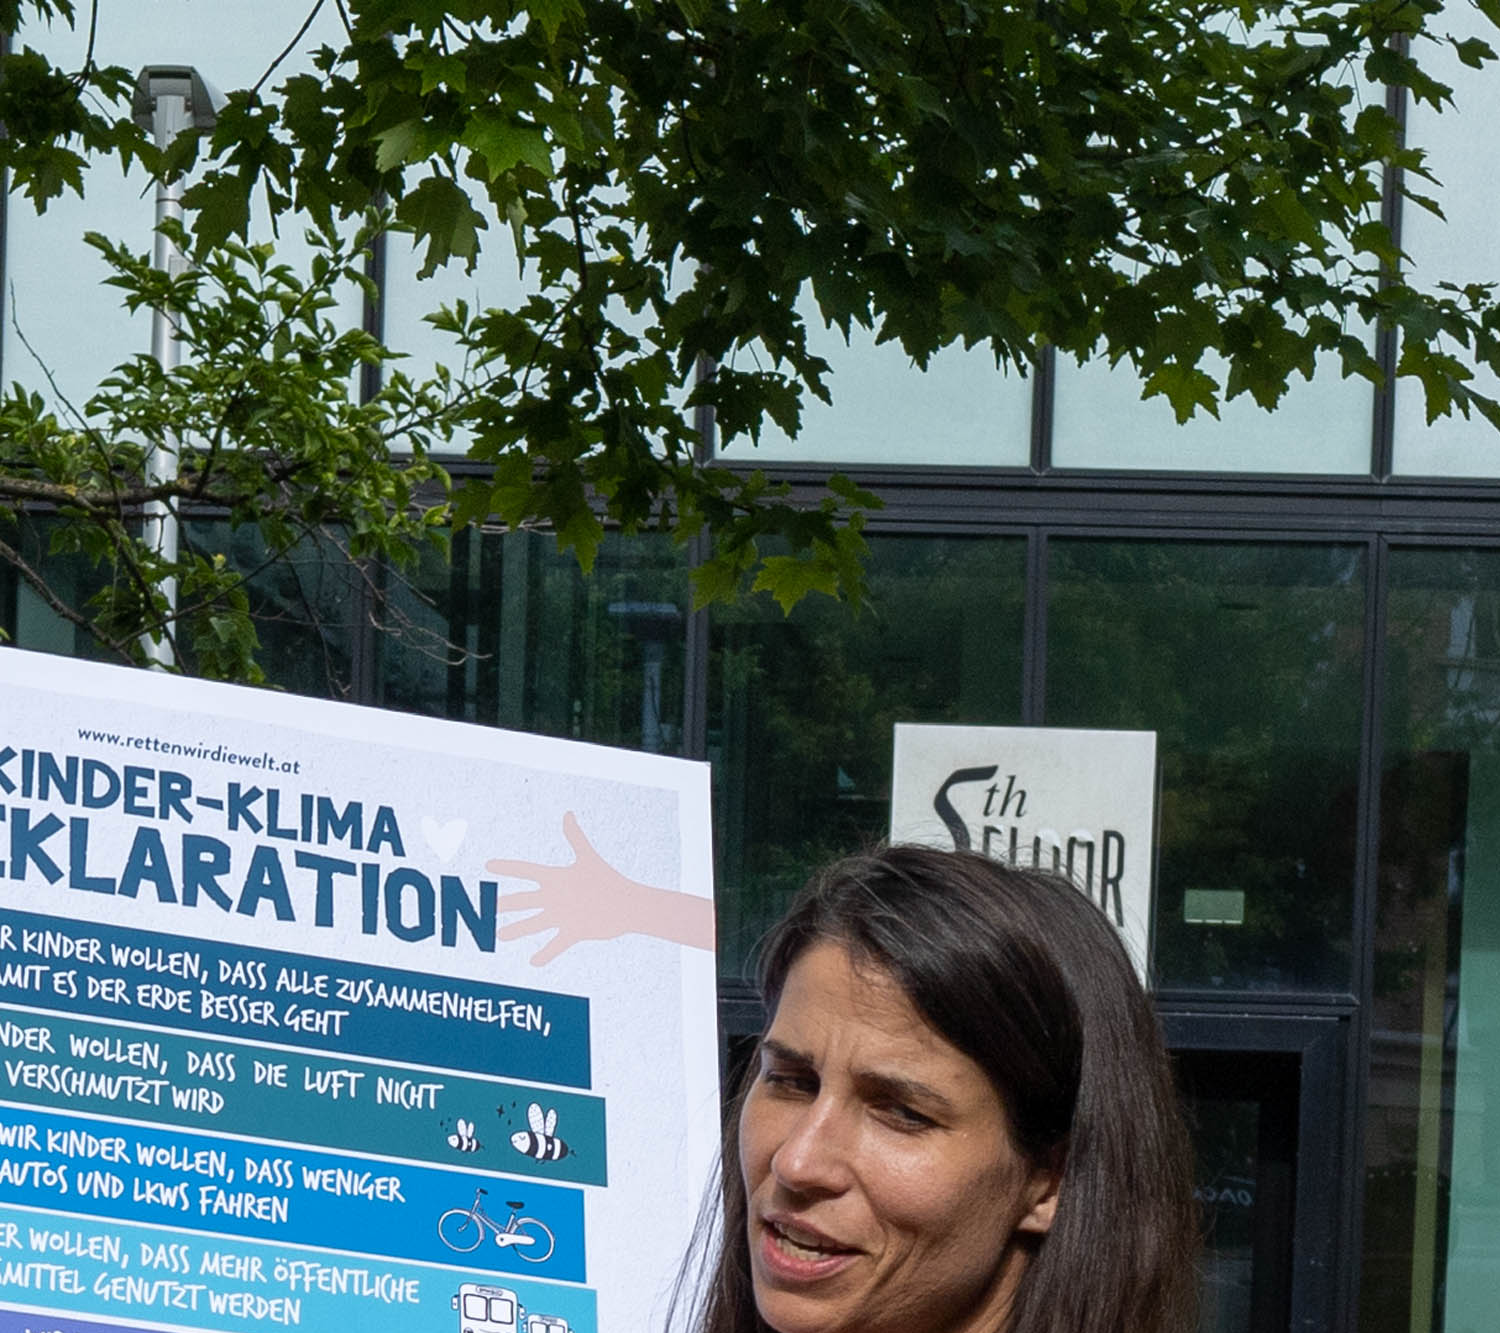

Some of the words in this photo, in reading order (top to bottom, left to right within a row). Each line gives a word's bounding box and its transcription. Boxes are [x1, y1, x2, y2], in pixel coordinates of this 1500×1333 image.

[77, 726, 301, 774] www.rettenwirdiewelt.at
[22, 929, 106, 965] KINDER
[110, 943, 209, 985] WOLLEN,
[218, 959, 267, 991] DASS
[275, 967, 329, 998] ALLE
[335, 978, 551, 1037] ZUSAMMENHELFEN,
[52, 969, 78, 998] ES
[87, 975, 131, 1005] DER
[136, 984, 192, 1014] ERDE
[200, 989, 280, 1027] BESSER
[283, 1003, 350, 1036] GEHT
[4, 1060, 170, 1106] VERSCHMUTZT
[171, 1085, 225, 1114] WIRD
[69, 1033, 168, 1076] WOLLEN,
[187, 1051, 236, 1082] DASS
[253, 1060, 288, 1088] DIE
[304, 1066, 365, 1100] LUFT
[376, 1076, 445, 1110] NICHT
[47, 1128, 131, 1164] KINDER
[135, 1142, 235, 1184] WOLLEN,
[244, 1157, 294, 1189] DASS
[302, 1166, 406, 1203] WENIGER
[76, 1170, 125, 1199] UND
[133, 1177, 190, 1211] LKWS
[199, 1185, 289, 1224] FAHREN
[28, 1227, 129, 1269] WOLLEN,
[140, 1242, 190, 1275] DASS
[199, 1251, 268, 1283] MEHR
[273, 1257, 420, 1304] ÖFFENTLICHE
[93, 1271, 207, 1311] GENUTZT
[208, 1290, 301, 1326] WERDEN
